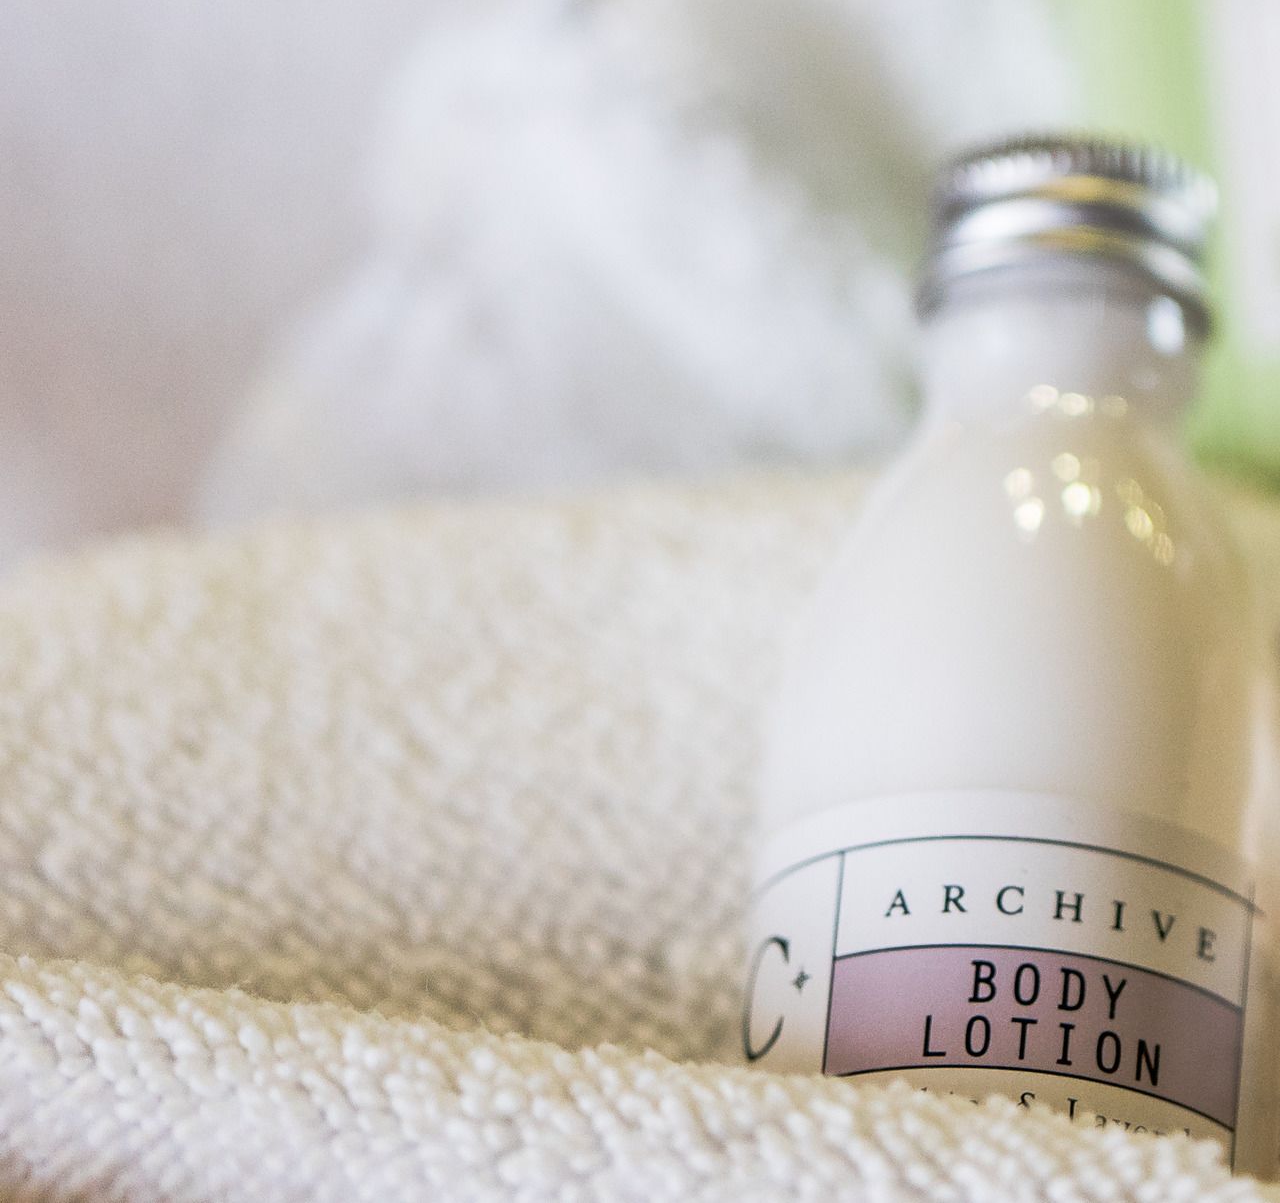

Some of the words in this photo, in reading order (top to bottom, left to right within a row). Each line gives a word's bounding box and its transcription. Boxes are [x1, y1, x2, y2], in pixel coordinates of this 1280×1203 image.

[885, 884, 1220, 962] ARCHIVE
[742, 935, 790, 1062] C
[968, 961, 1127, 1020] BODY
[922, 1015, 1161, 1087] LOTION
